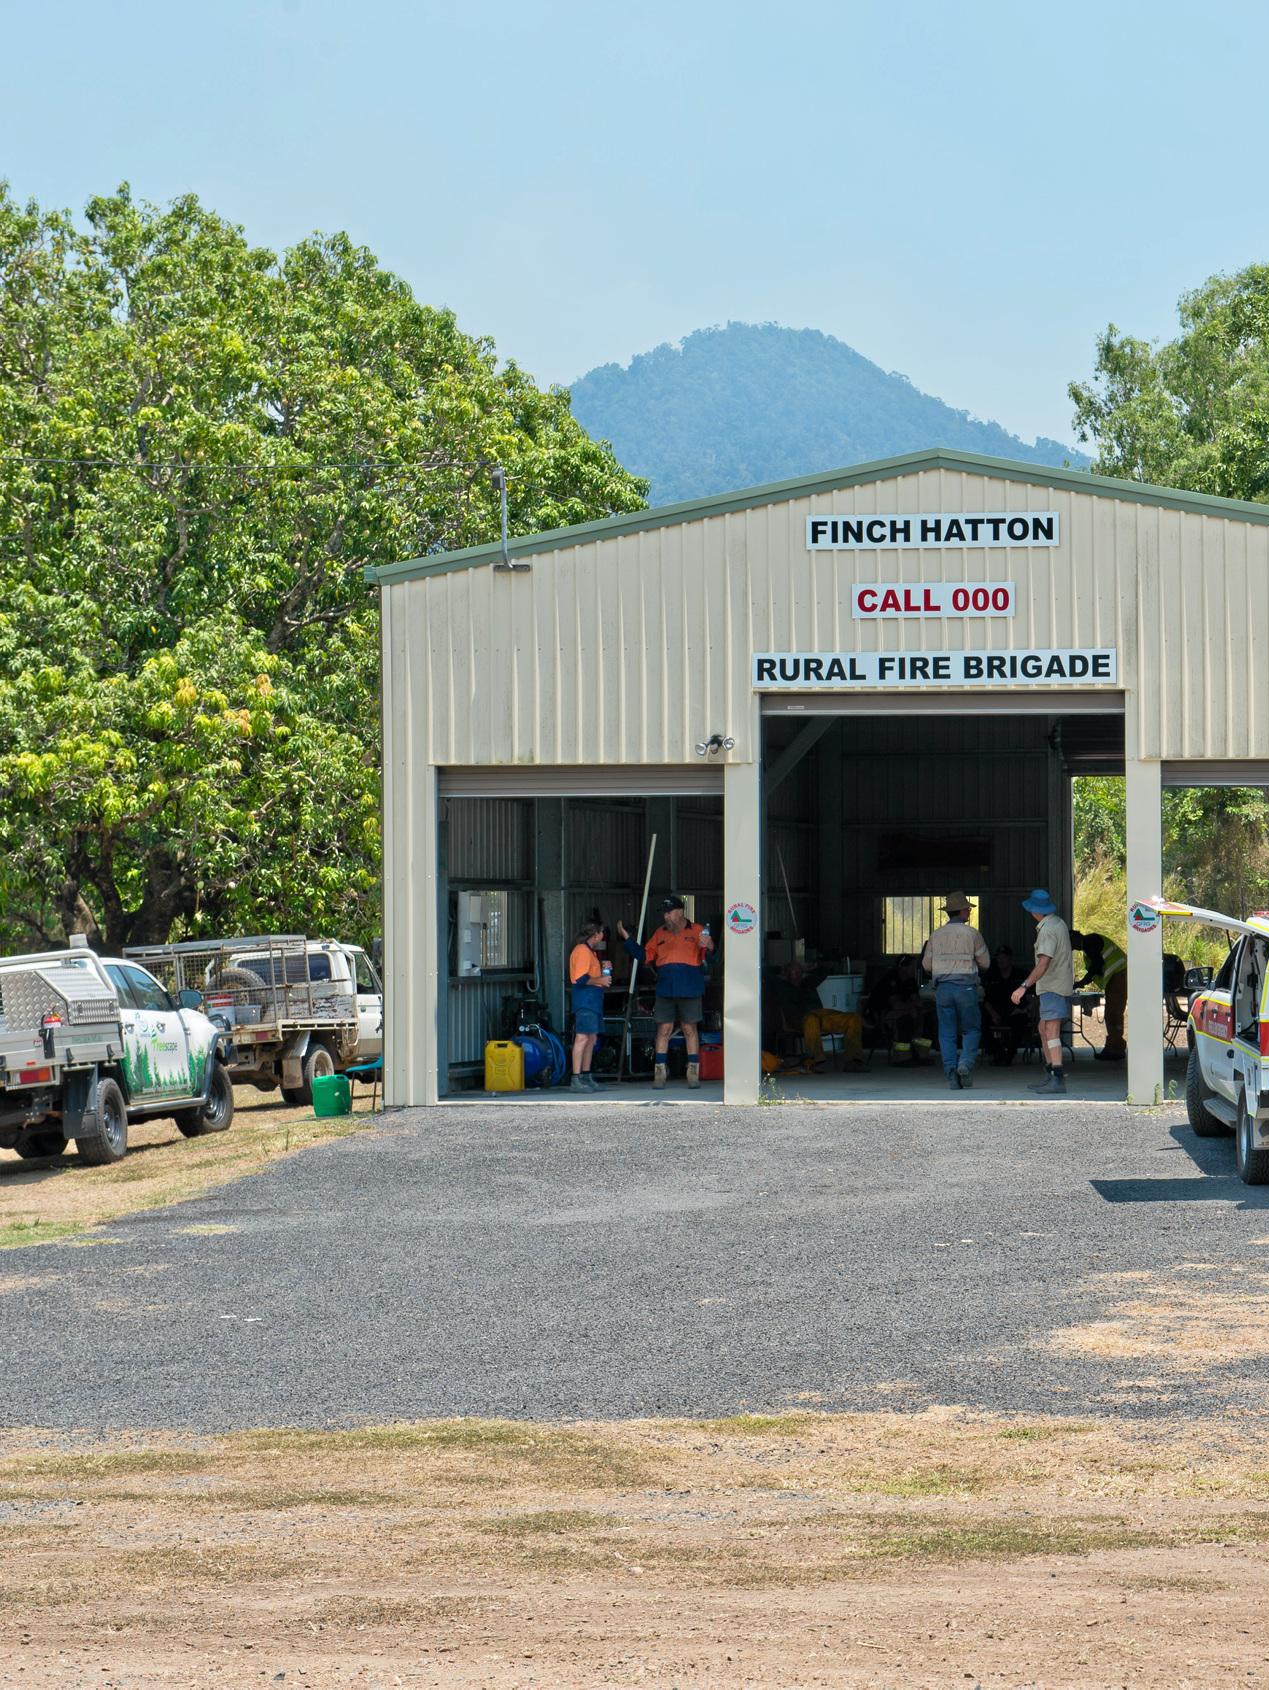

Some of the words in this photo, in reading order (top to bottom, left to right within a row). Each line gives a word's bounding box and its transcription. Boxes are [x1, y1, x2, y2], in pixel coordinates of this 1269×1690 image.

[811, 520, 911, 544] FINCH
[920, 517, 1054, 542] HATTON
[856, 588, 941, 613] CALL
[951, 587, 1010, 612] 000
[756, 657, 866, 682] RURAL
[878, 656, 951, 681] FIRE
[963, 653, 1111, 679] BRIGADE
